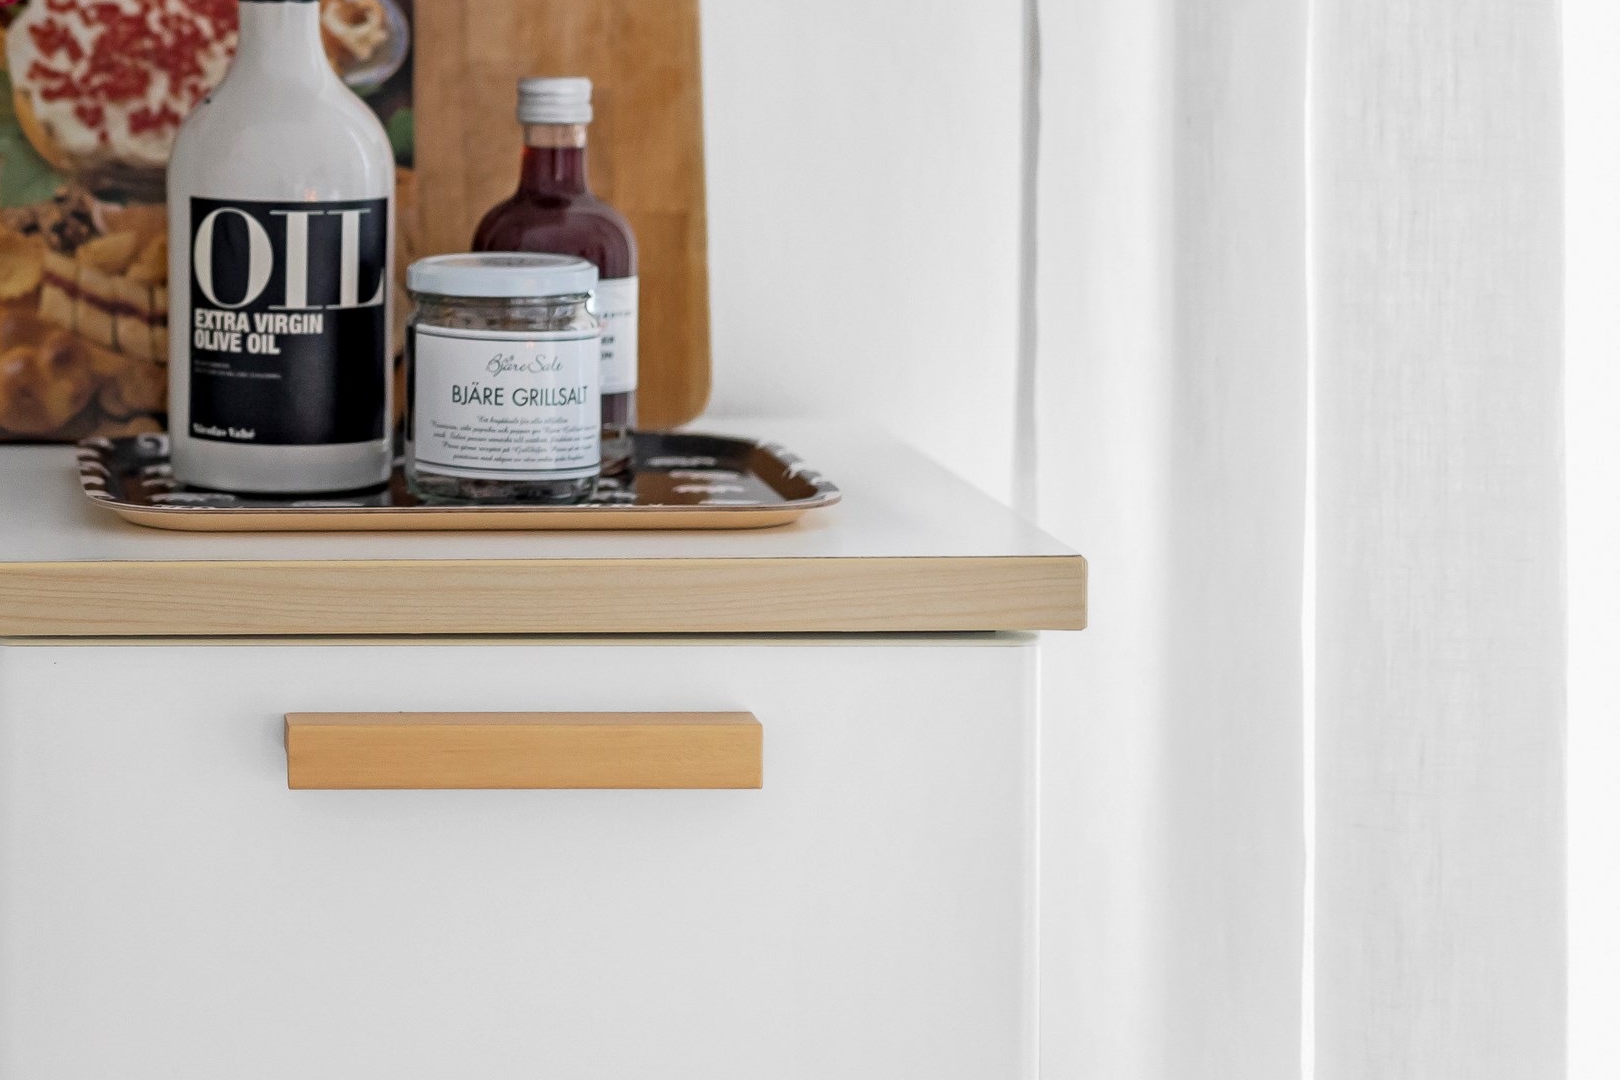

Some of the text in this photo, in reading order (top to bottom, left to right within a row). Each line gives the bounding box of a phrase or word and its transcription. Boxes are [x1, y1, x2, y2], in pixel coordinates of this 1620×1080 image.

[193, 206, 385, 310] OIL
[194, 308, 324, 334] EXTRA VIRGIN
[194, 329, 281, 354] OLIVE OIL
[452, 381, 588, 407] BJÄRE GRILLSALT
